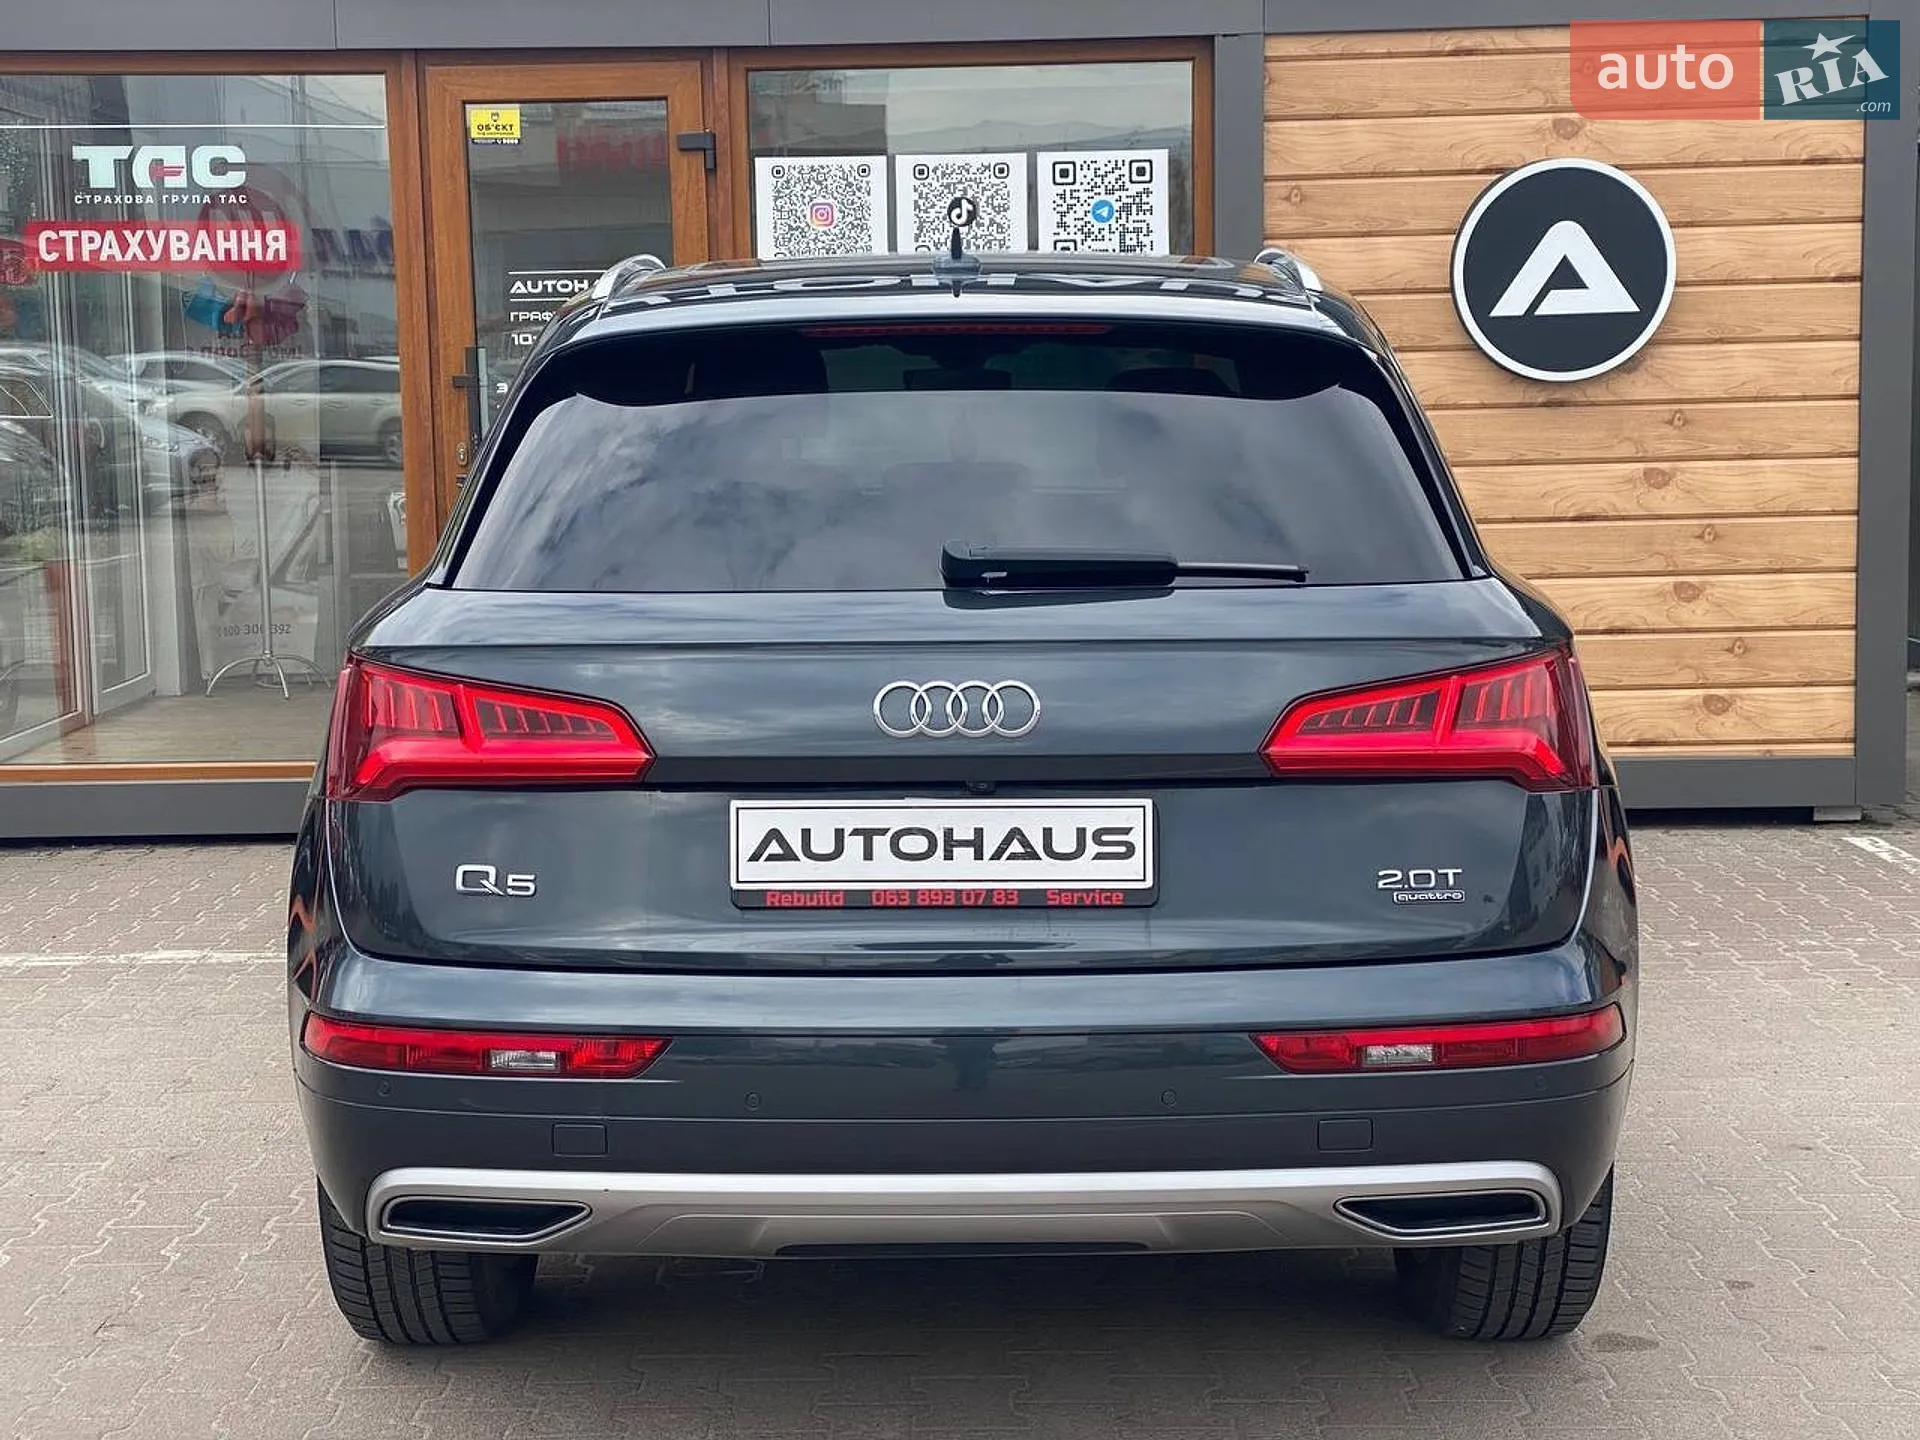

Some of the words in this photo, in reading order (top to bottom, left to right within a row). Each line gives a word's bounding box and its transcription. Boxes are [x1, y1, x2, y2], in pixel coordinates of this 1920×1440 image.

[74, 194, 154, 205] СТРАХОВА
[162, 194, 212, 205] ГРУПА
[219, 194, 248, 205] ТАС
[38, 229, 287, 262] СТРАХУВАННЯ
[509, 279, 599, 294] AUTOH
[510, 311, 556, 322] ГРАФ
[747, 826, 1136, 862] AUTOHAUS
[456, 864, 535, 896] Q5
[1378, 868, 1462, 888] 2.0T
[766, 890, 845, 907] Rebuild
[872, 889, 910, 906] 063
[917, 889, 955, 906] 893
[961, 889, 987, 906] 07
[993, 889, 1019, 906] 83
[1046, 888, 1125, 906] Service
[1397, 892, 1463, 902] quattro
